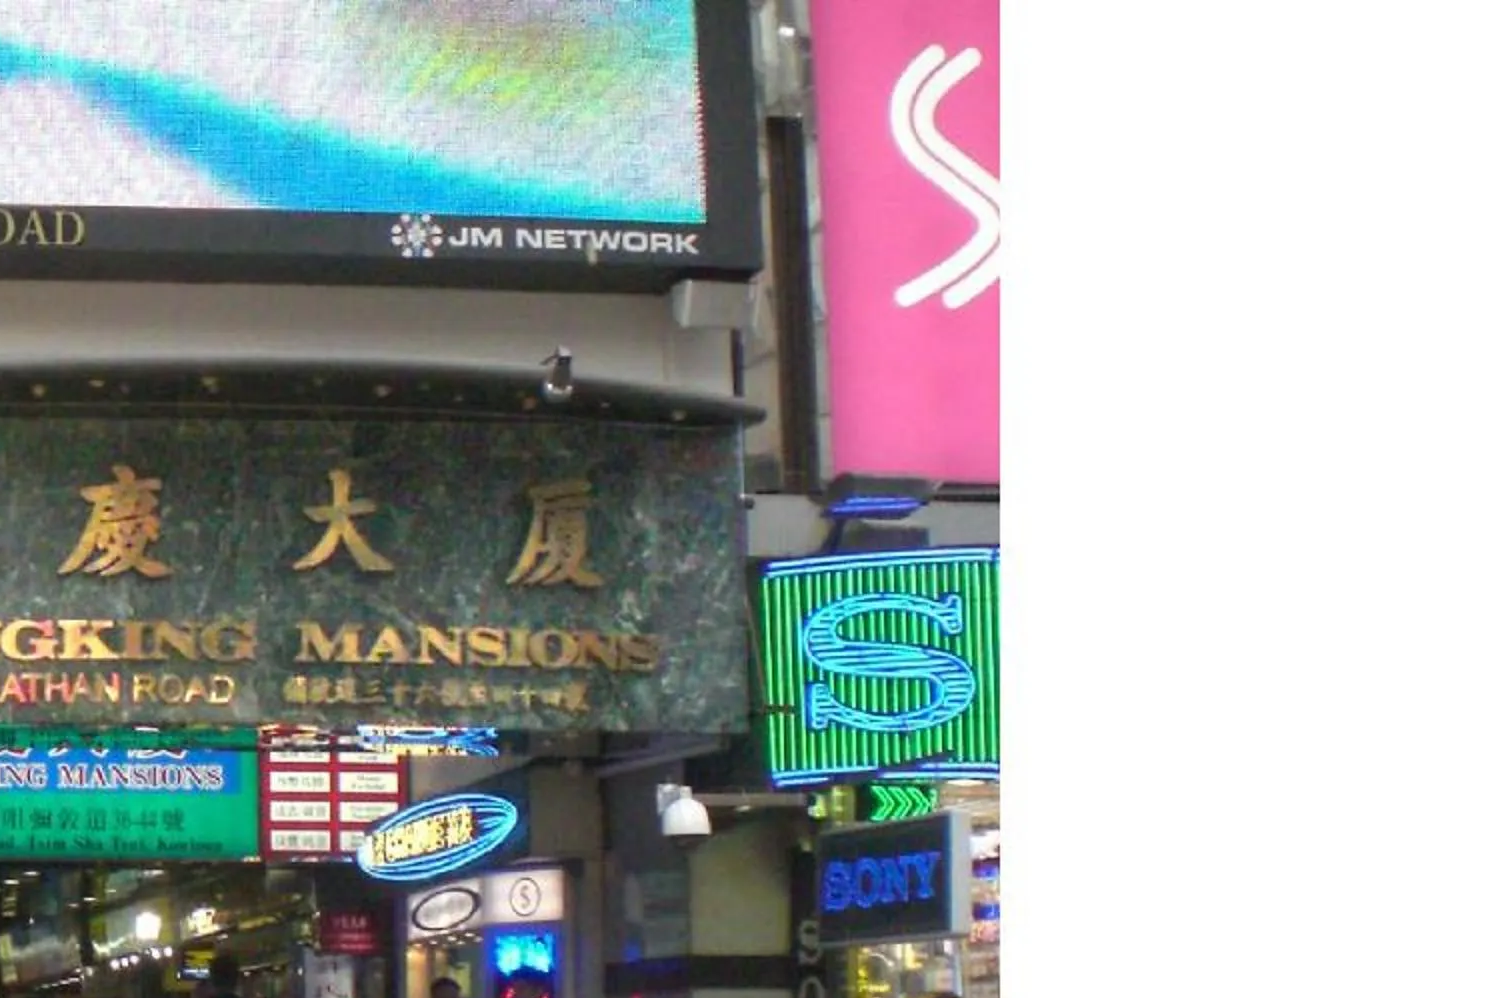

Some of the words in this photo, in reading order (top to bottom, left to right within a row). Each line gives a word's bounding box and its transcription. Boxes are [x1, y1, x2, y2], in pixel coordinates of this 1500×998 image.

[450, 227, 503, 248] JM
[515, 229, 700, 255] NETWORK
[294, 621, 662, 674] MANSIONS
[803, 593, 977, 733] S
[133, 673, 237, 705] ROAD
[57, 763, 225, 791] MANSIONS
[820, 850, 942, 912] SONY
